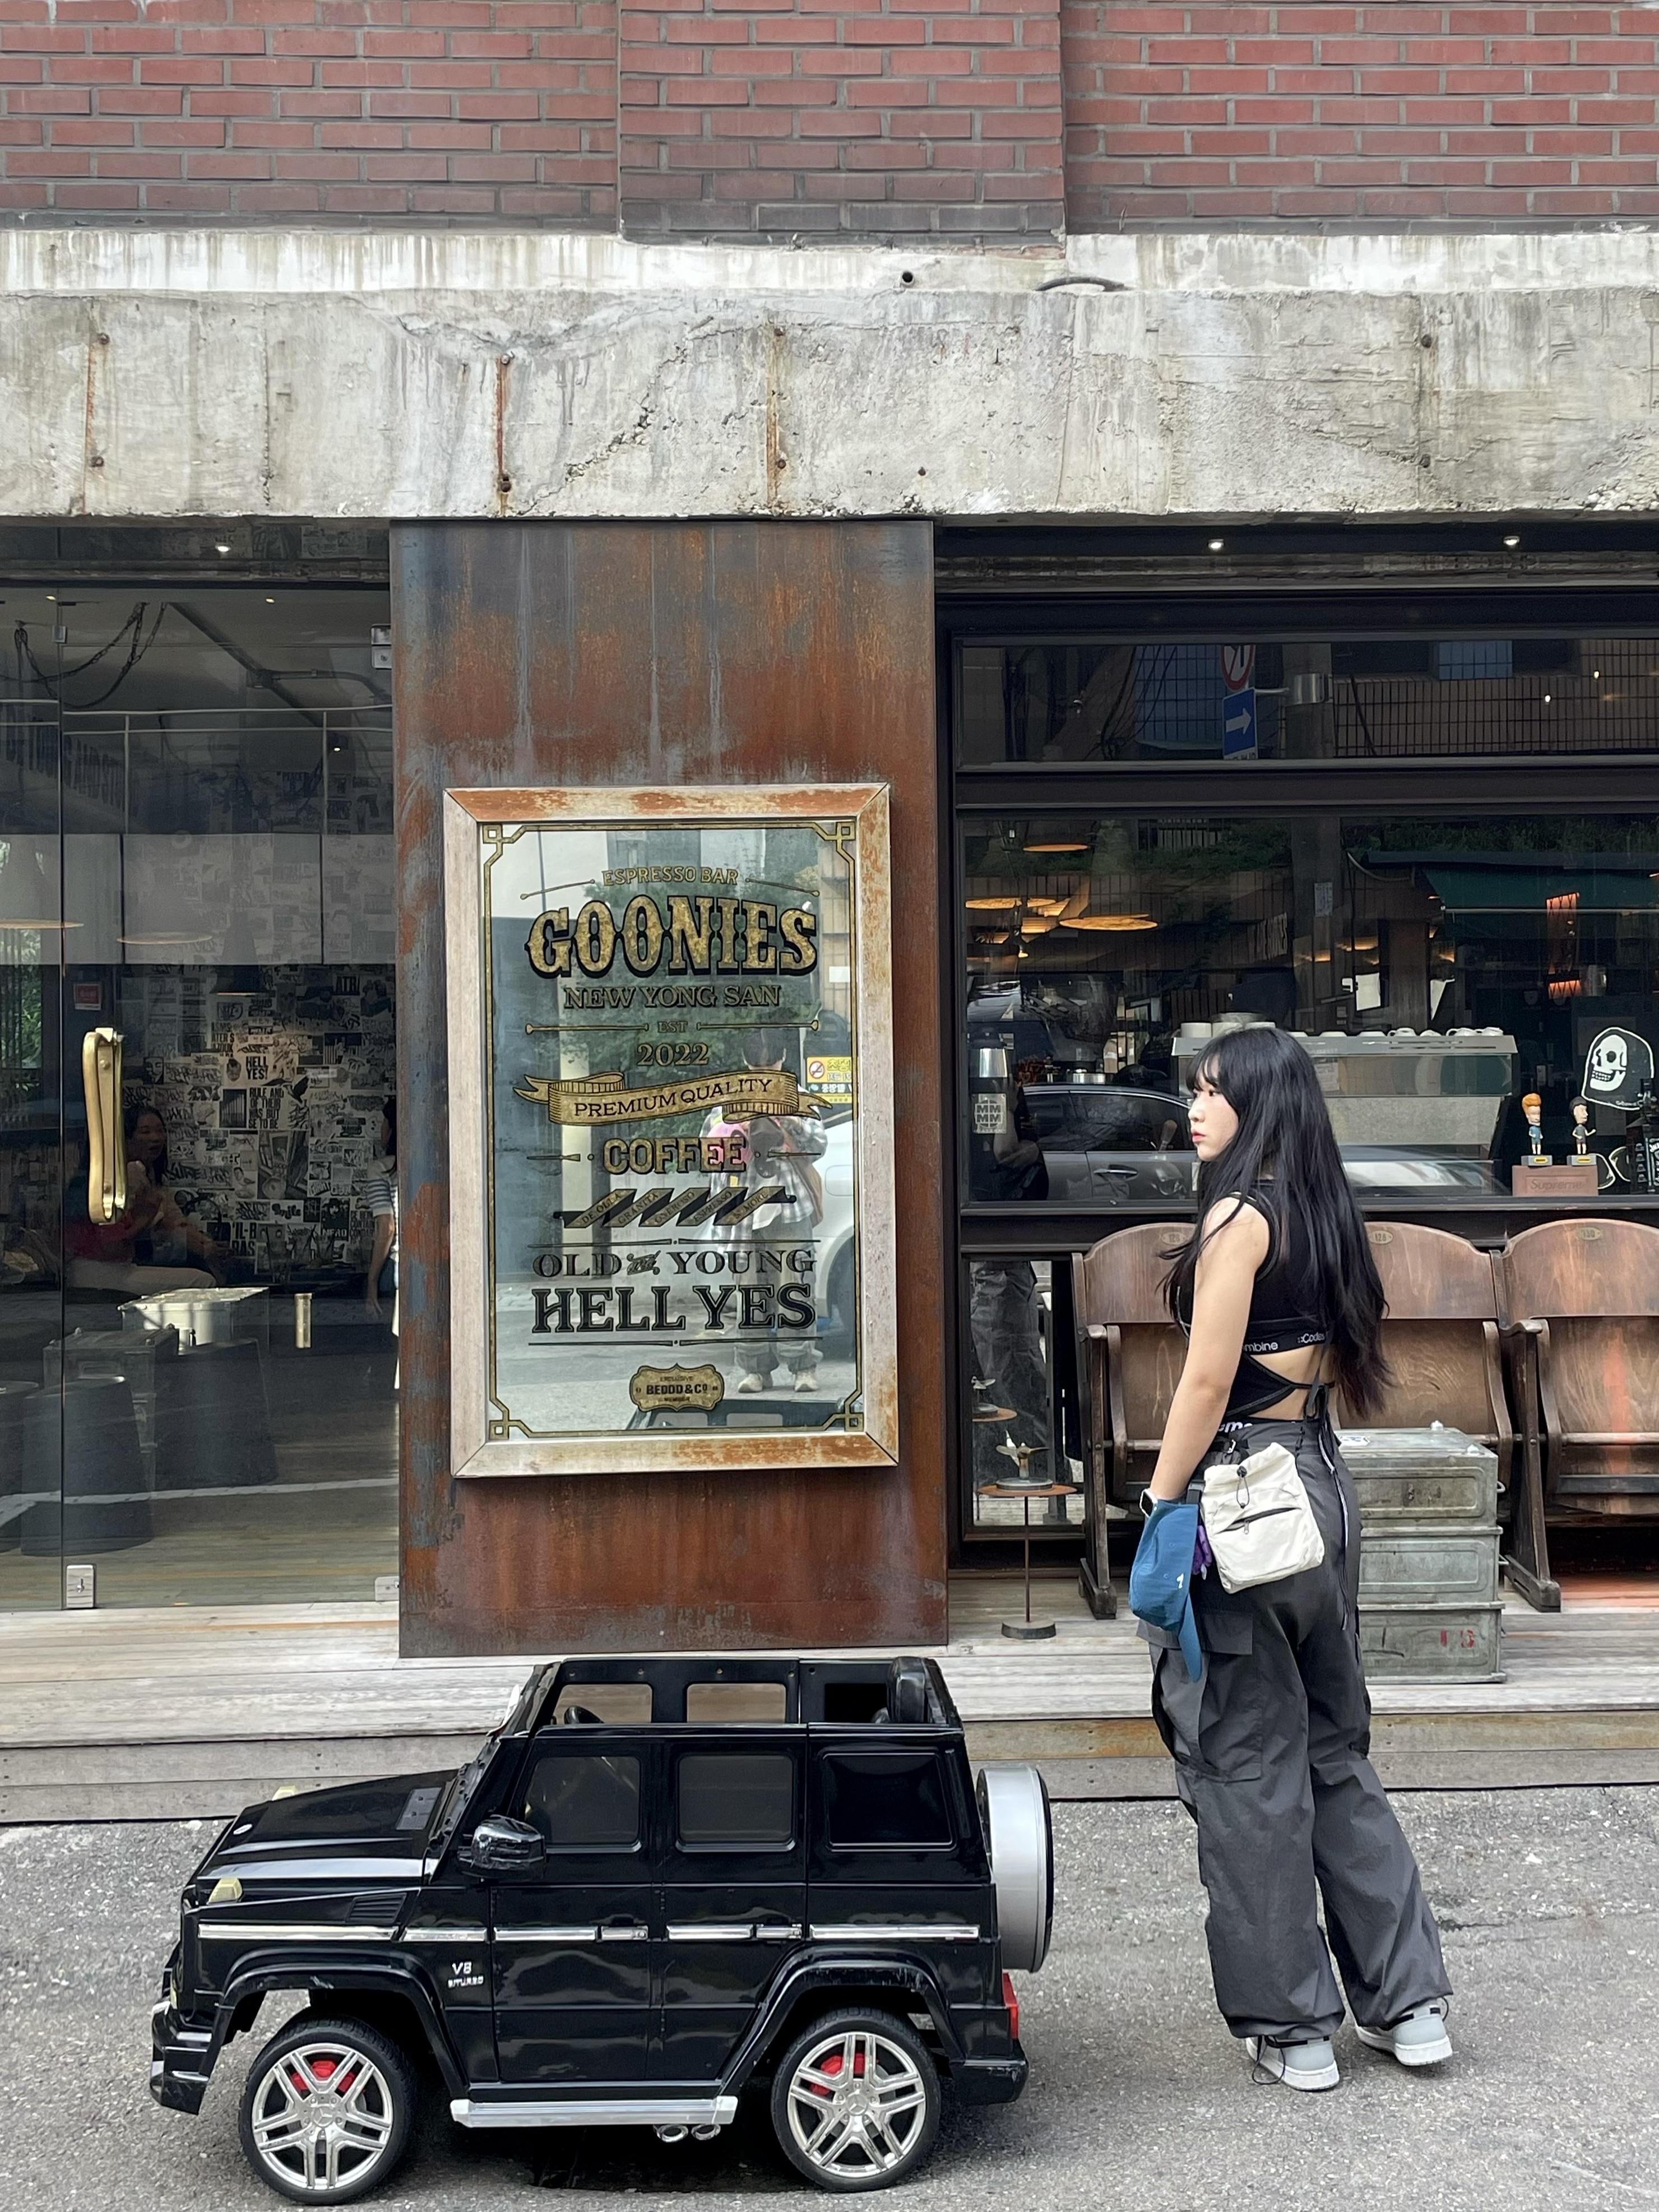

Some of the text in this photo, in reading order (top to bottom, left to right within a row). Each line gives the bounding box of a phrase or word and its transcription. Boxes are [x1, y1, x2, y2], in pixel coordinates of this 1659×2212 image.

[601, 866, 739, 887] ESPRESSO BAR
[524, 894, 817, 979] GOONIES
[564, 984, 782, 1009] NEW YONG SAN
[657, 1021, 689, 1033] EST
[245, 1056, 267, 1068] HELL
[636, 1042, 710, 1066] 2022
[246, 1066, 268, 1080] YES!
[574, 1079, 774, 1117] PREMIUM QUALITY
[603, 1137, 747, 1175] COFFEE
[1530, 1178, 1584, 1190] Supreme
[582, 1193, 622, 1223] DE OLLA
[618, 1193, 659, 1224] GRANITA
[694, 1191, 733, 1222] ESPRESSO
[532, 1253, 622, 1278] OLD
[667, 1250, 817, 1274] YOUNG
[531, 1283, 816, 1333] HELL YES
[1243, 1342, 1278, 1352] mbine
[452, 1961, 472, 1975] V8
